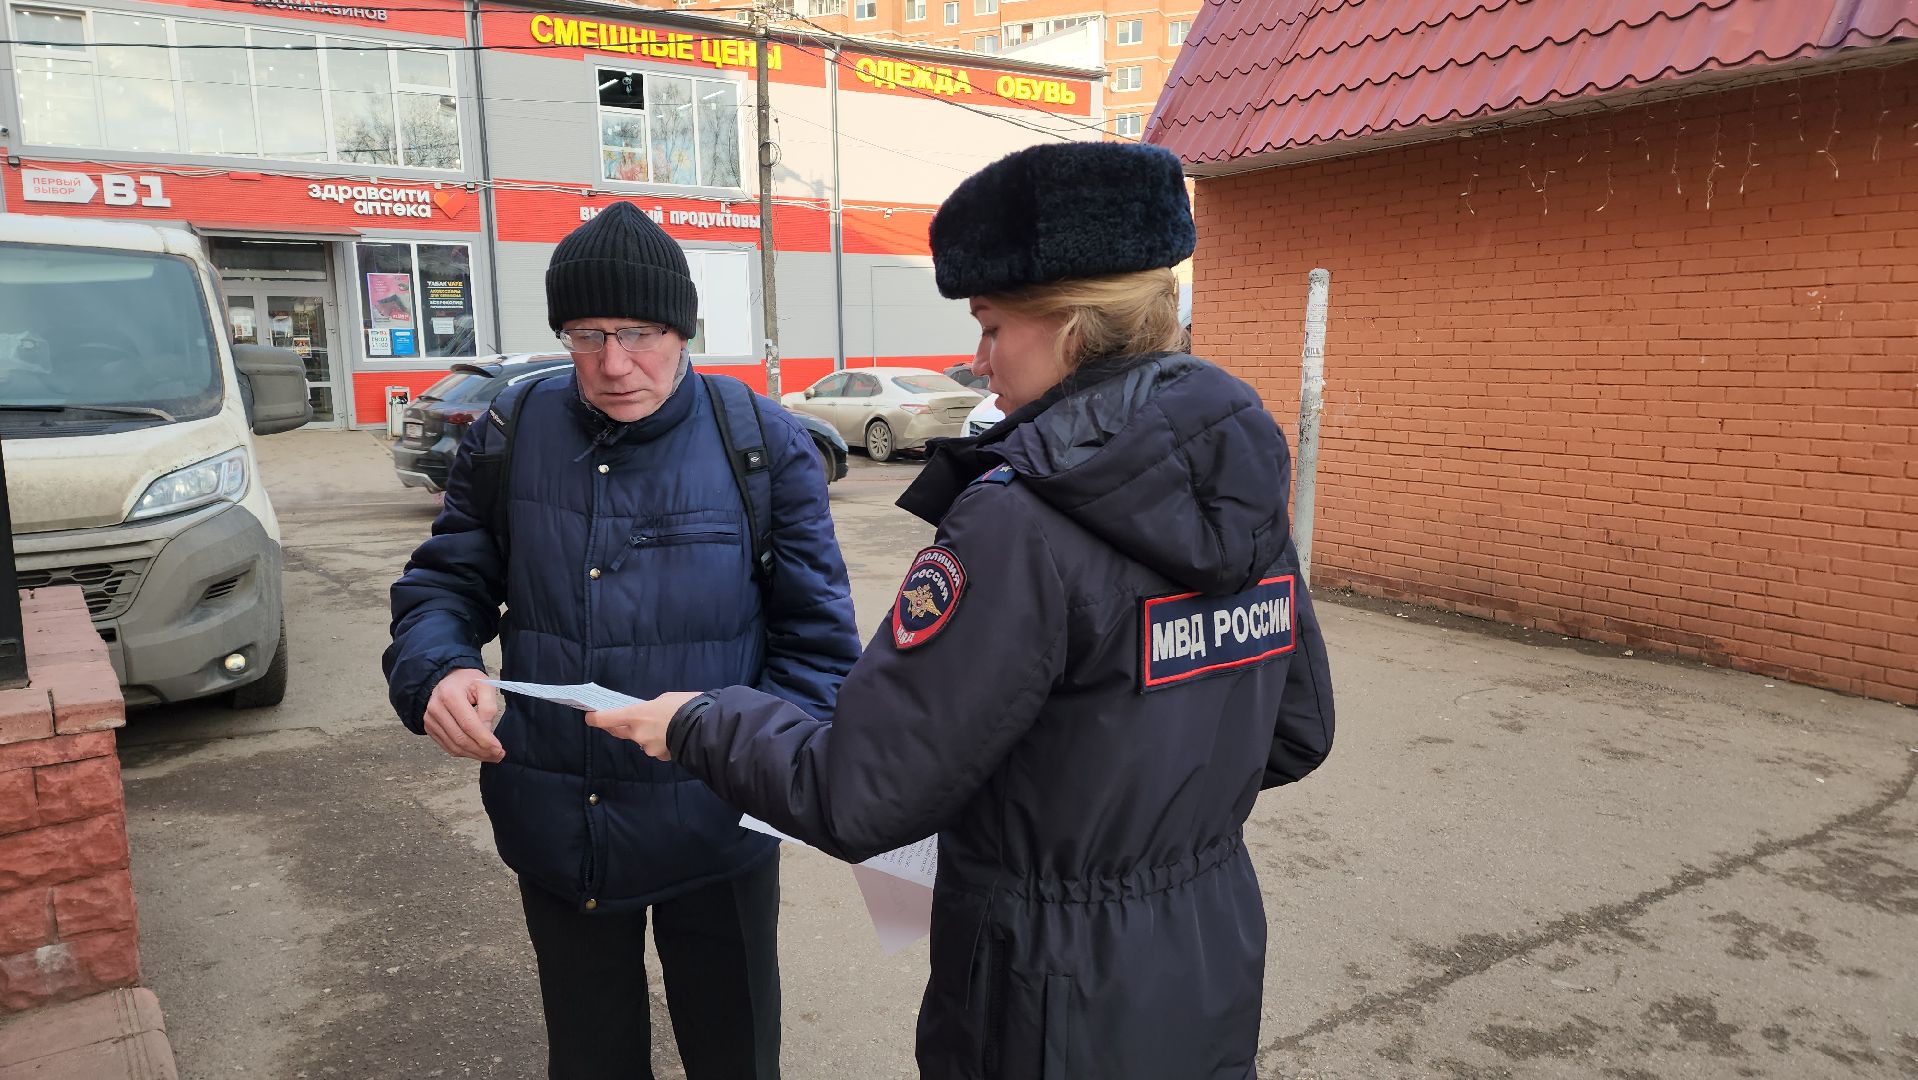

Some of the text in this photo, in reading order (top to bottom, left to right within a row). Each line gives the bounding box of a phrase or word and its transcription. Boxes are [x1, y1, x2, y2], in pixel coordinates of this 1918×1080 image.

[530, 15, 695, 60] СМЕШНЫЕ
[855, 58, 1076, 105] ОДЕЖДА ОБУВЬ
[33, 177, 81, 187] ПЕРВЫЙ
[34, 186, 75, 195] ВЫБОР
[308, 183, 430, 204] здравсити
[353, 201, 432, 219] аптека
[670, 210, 761, 229] ПРОДУКТОВЫ
[916, 552, 961, 588] ПОЛИЦИЯ
[910, 569, 949, 602] РОССИЯ
[1152, 597, 1291, 661] МВД РОССИИ
